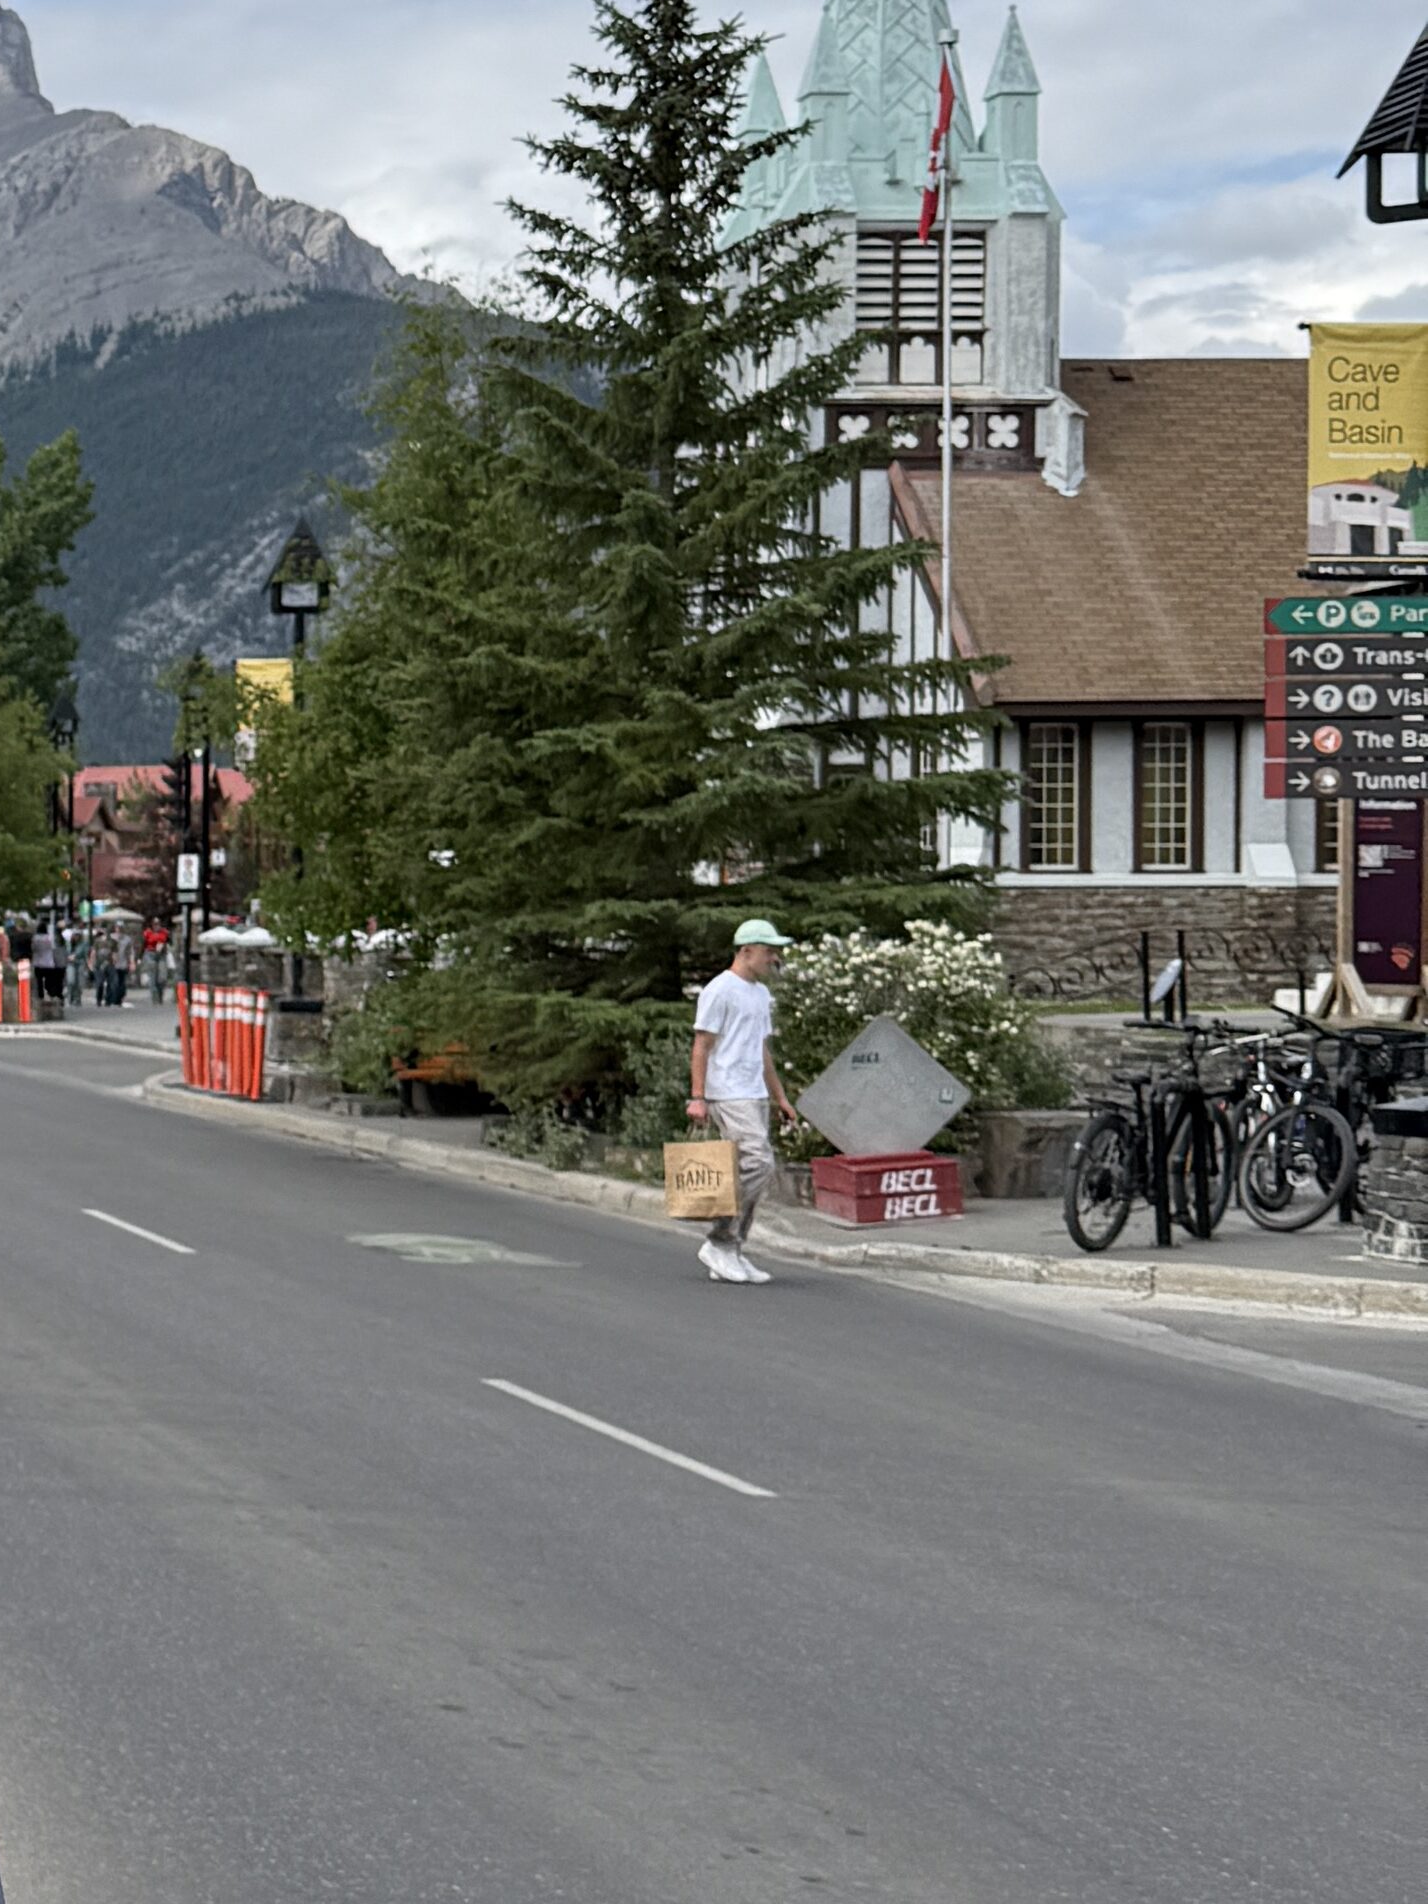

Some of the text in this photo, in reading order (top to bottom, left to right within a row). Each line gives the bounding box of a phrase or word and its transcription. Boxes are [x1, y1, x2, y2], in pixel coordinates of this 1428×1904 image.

[1328, 356, 1400, 383] Cave
[1328, 386, 1380, 412] and
[1328, 417, 1403, 444] Basin
[1352, 646, 1428, 666] Trans-
[1352, 730, 1395, 749] The
[1352, 770, 1428, 790] Tunnel
[880, 1168, 938, 1194] BECL
[884, 1194, 942, 1220] BECL
